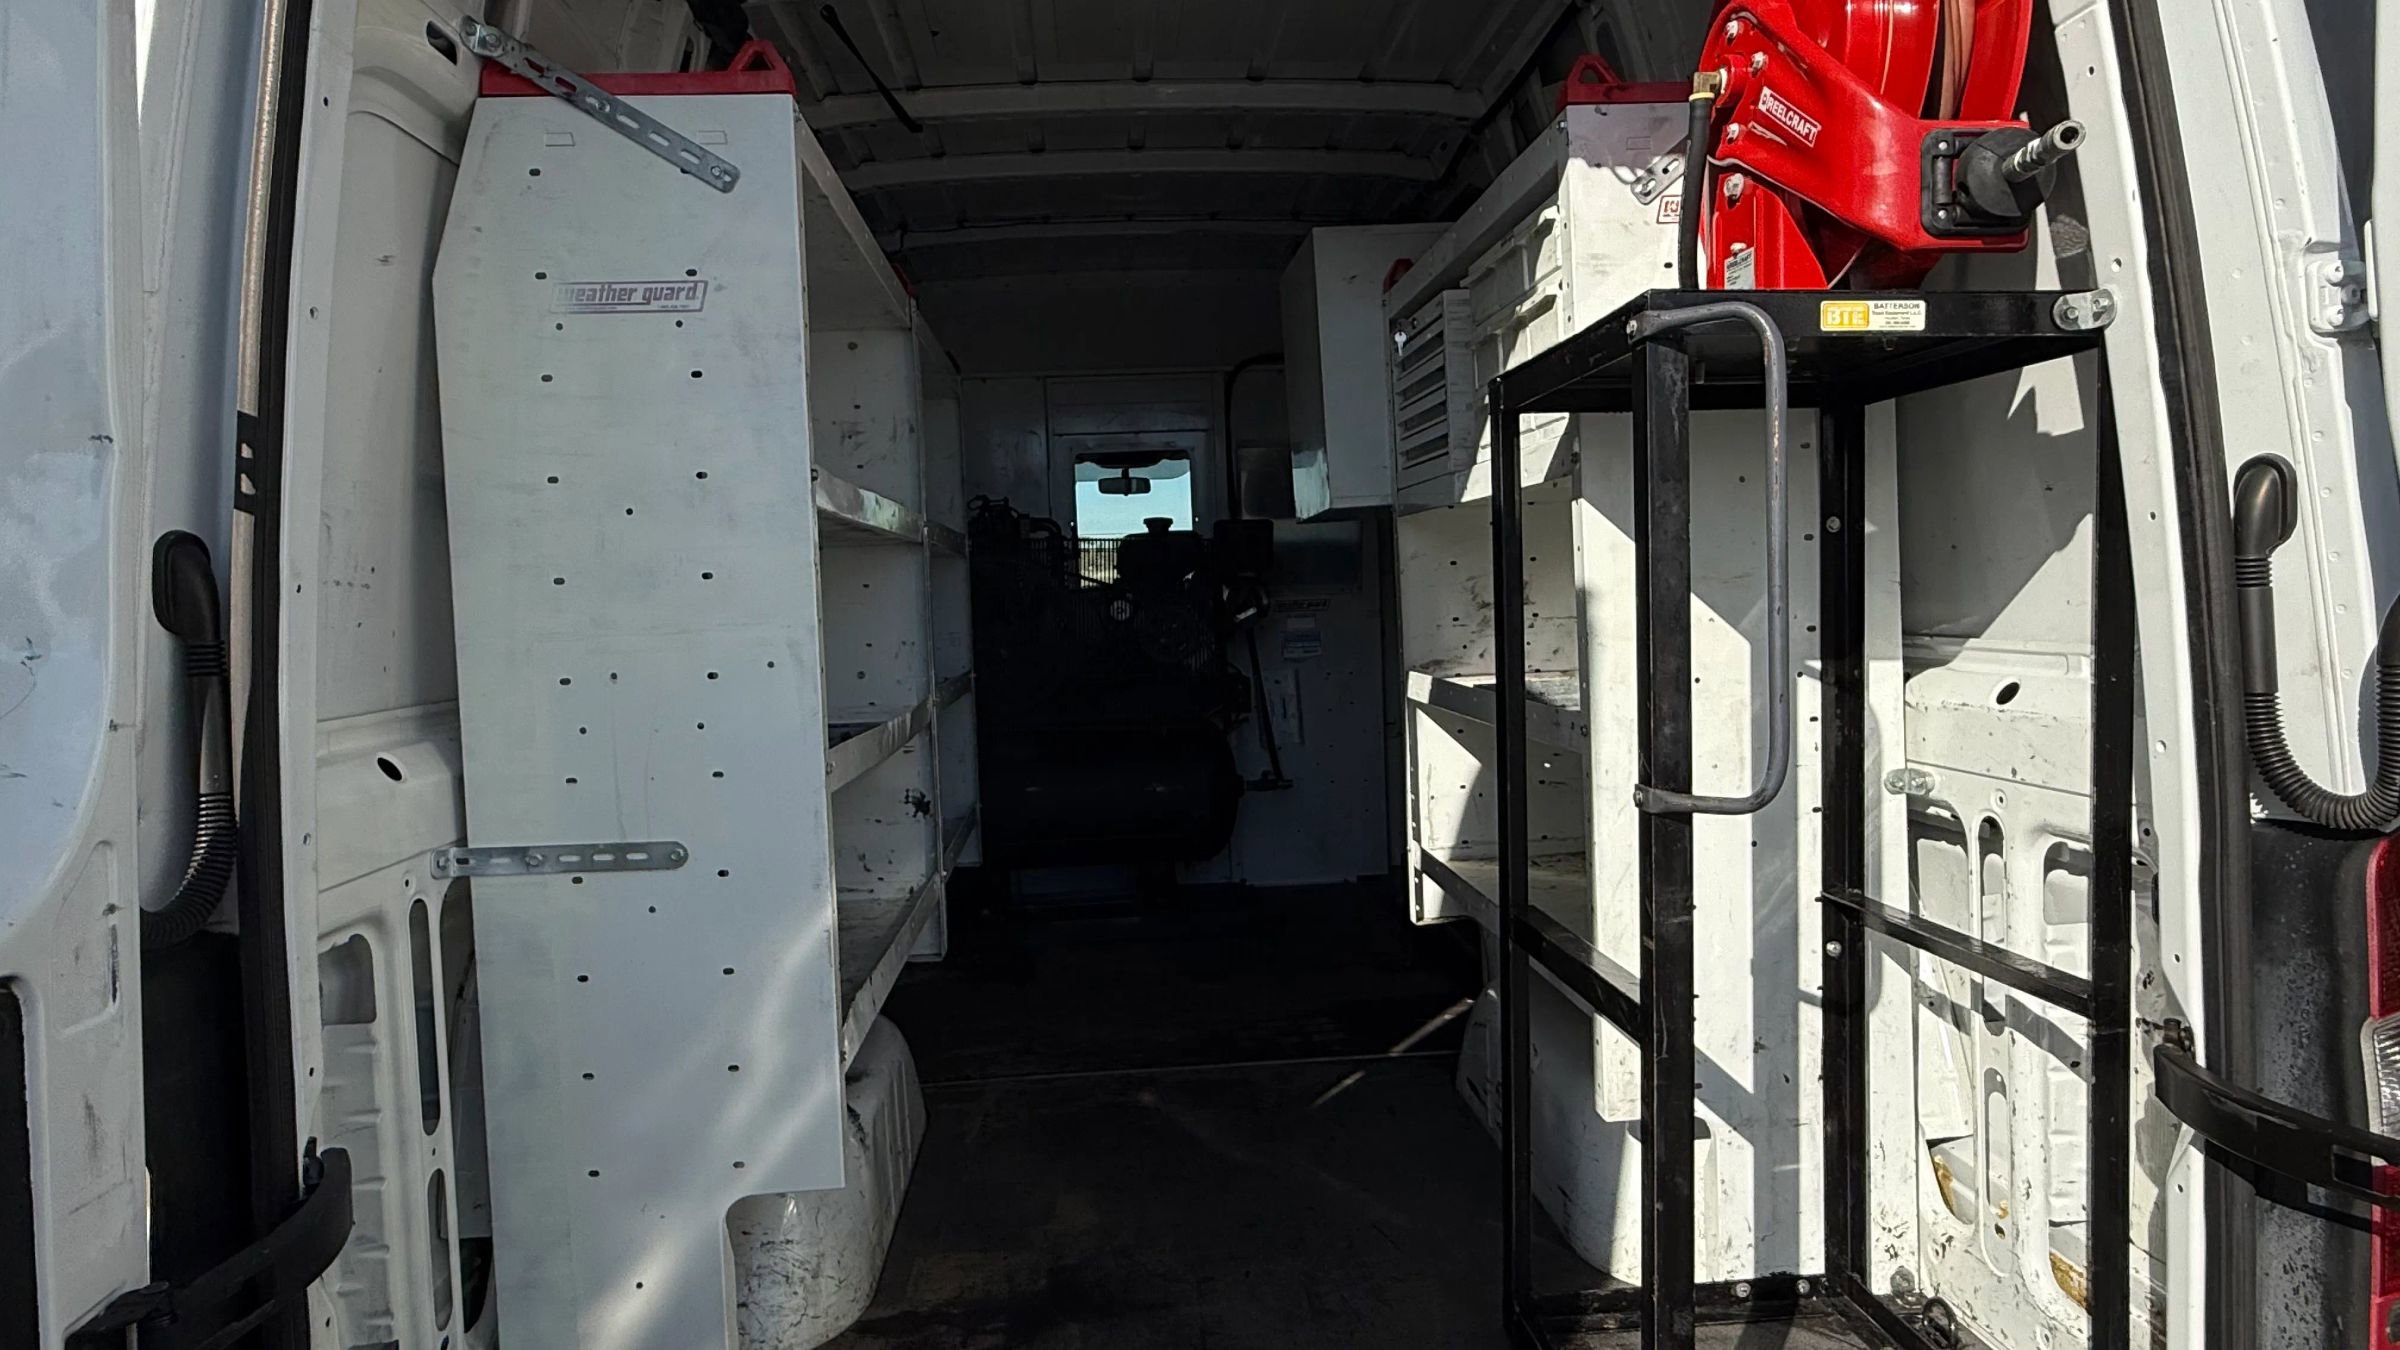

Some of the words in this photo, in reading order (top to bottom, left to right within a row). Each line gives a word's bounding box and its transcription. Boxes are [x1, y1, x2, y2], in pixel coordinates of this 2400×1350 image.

[1767, 96, 1817, 141] REELCRAFT
[642, 282, 697, 305] guard
[1827, 306, 1865, 326] BTE
